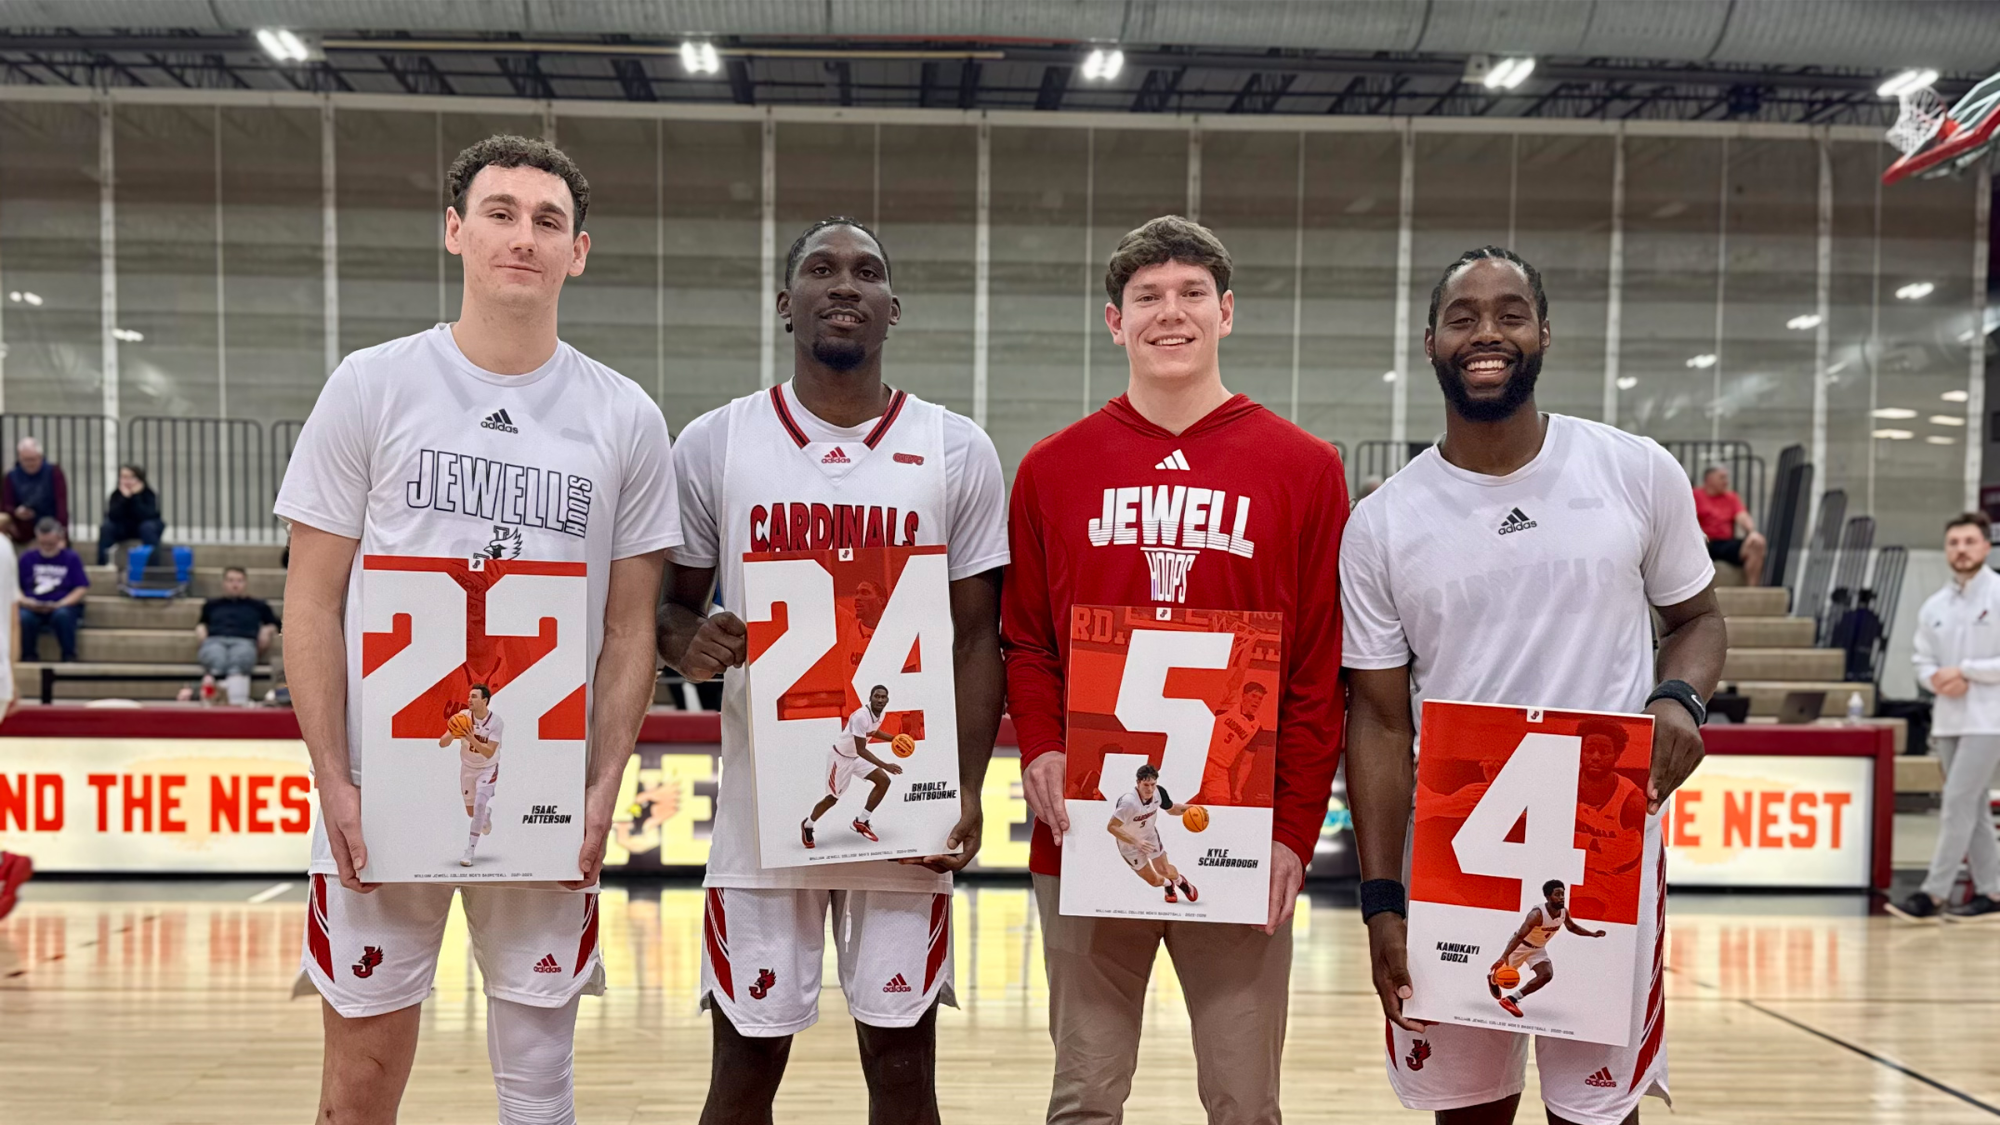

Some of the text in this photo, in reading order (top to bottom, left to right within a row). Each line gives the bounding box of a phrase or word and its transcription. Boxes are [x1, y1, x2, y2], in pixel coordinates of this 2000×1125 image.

[480, 420, 519, 434] adidas
[821, 456, 851, 464] adidas
[406, 448, 565, 532] JEWELL
[564, 474, 593, 539] HOOPS
[750, 502, 920, 554] CARDINALS
[1088, 484, 1255, 559] JEWELL
[1498, 518, 1538, 536] adidas
[1144, 550, 1197, 604] HOOPS
[362, 569, 587, 740] 22
[743, 554, 958, 743] 24
[1098, 629, 1235, 806] 5
[911, 781, 947, 792] BRADLEY
[904, 789, 957, 802] LIGHTBOURNE
[87, 773, 188, 833] THE
[209, 774, 319, 834] NES
[531, 805, 558, 814] ISAAC
[522, 814, 572, 824] PATTERSON
[1451, 732, 1587, 920] 4
[1722, 790, 1851, 849] NEST
[1207, 848, 1229, 858] KYLE
[1198, 857, 1259, 869] SCHARBROUGH
[1436, 941, 1481, 955] KANUKAYI
[1440, 951, 1469, 964] GUDZA
[533, 965, 562, 974] adidas
[882, 985, 912, 993] adidas
[1584, 1078, 1617, 1088] adidas
